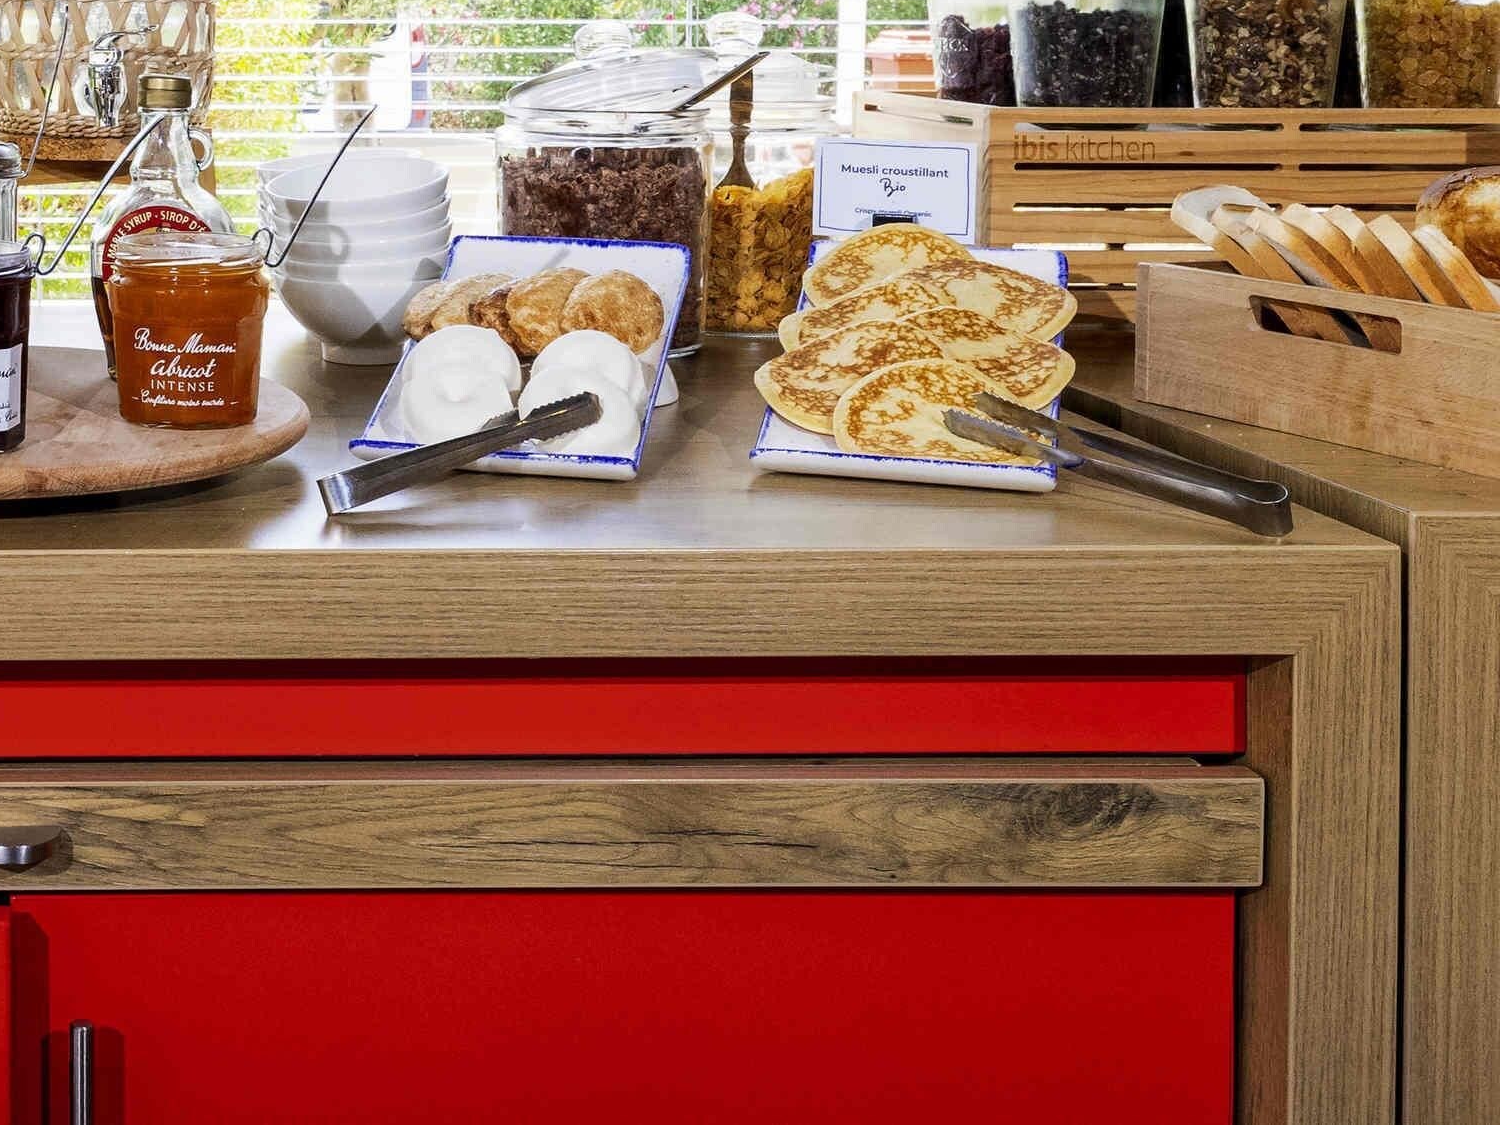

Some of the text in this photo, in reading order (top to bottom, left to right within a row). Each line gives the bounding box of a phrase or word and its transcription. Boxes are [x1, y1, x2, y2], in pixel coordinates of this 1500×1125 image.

[1013, 134, 1156, 161] ibis kitchen
[840, 163, 949, 179] Muesli croustillant
[879, 177, 907, 197] Bio
[107, 228, 127, 259] MAPLE
[124, 211, 152, 232] SYRUP
[160, 210, 189, 225] SIROP
[134, 327, 177, 352] Bonne
[150, 379, 215, 392] INTENSE
